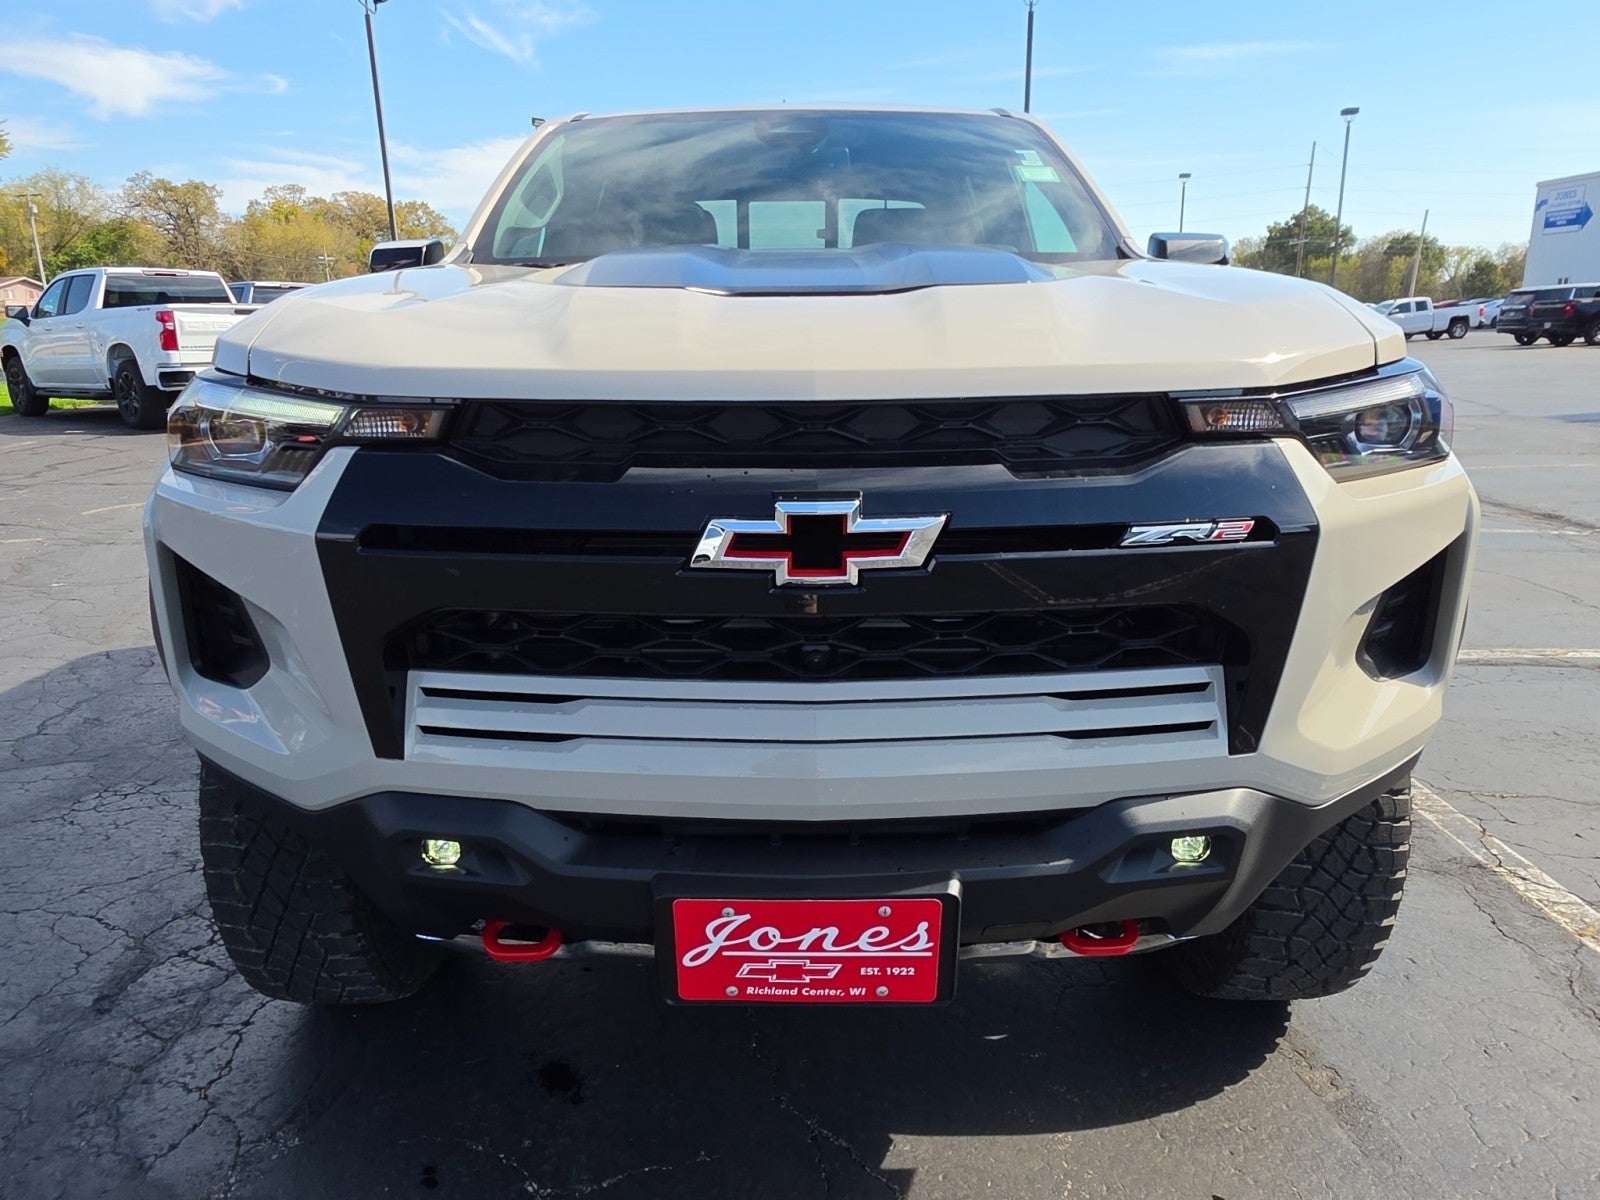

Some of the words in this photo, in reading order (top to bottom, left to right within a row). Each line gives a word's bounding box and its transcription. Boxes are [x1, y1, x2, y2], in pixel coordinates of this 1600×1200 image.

[1121, 520, 1255, 546] ZR2
[682, 913, 934, 967] Jones
[860, 967, 882, 976] EST.
[886, 967, 915, 976] 1922
[746, 987, 798, 996] Richland
[801, 987, 845, 997] Center,
[849, 987, 866, 996] WI
